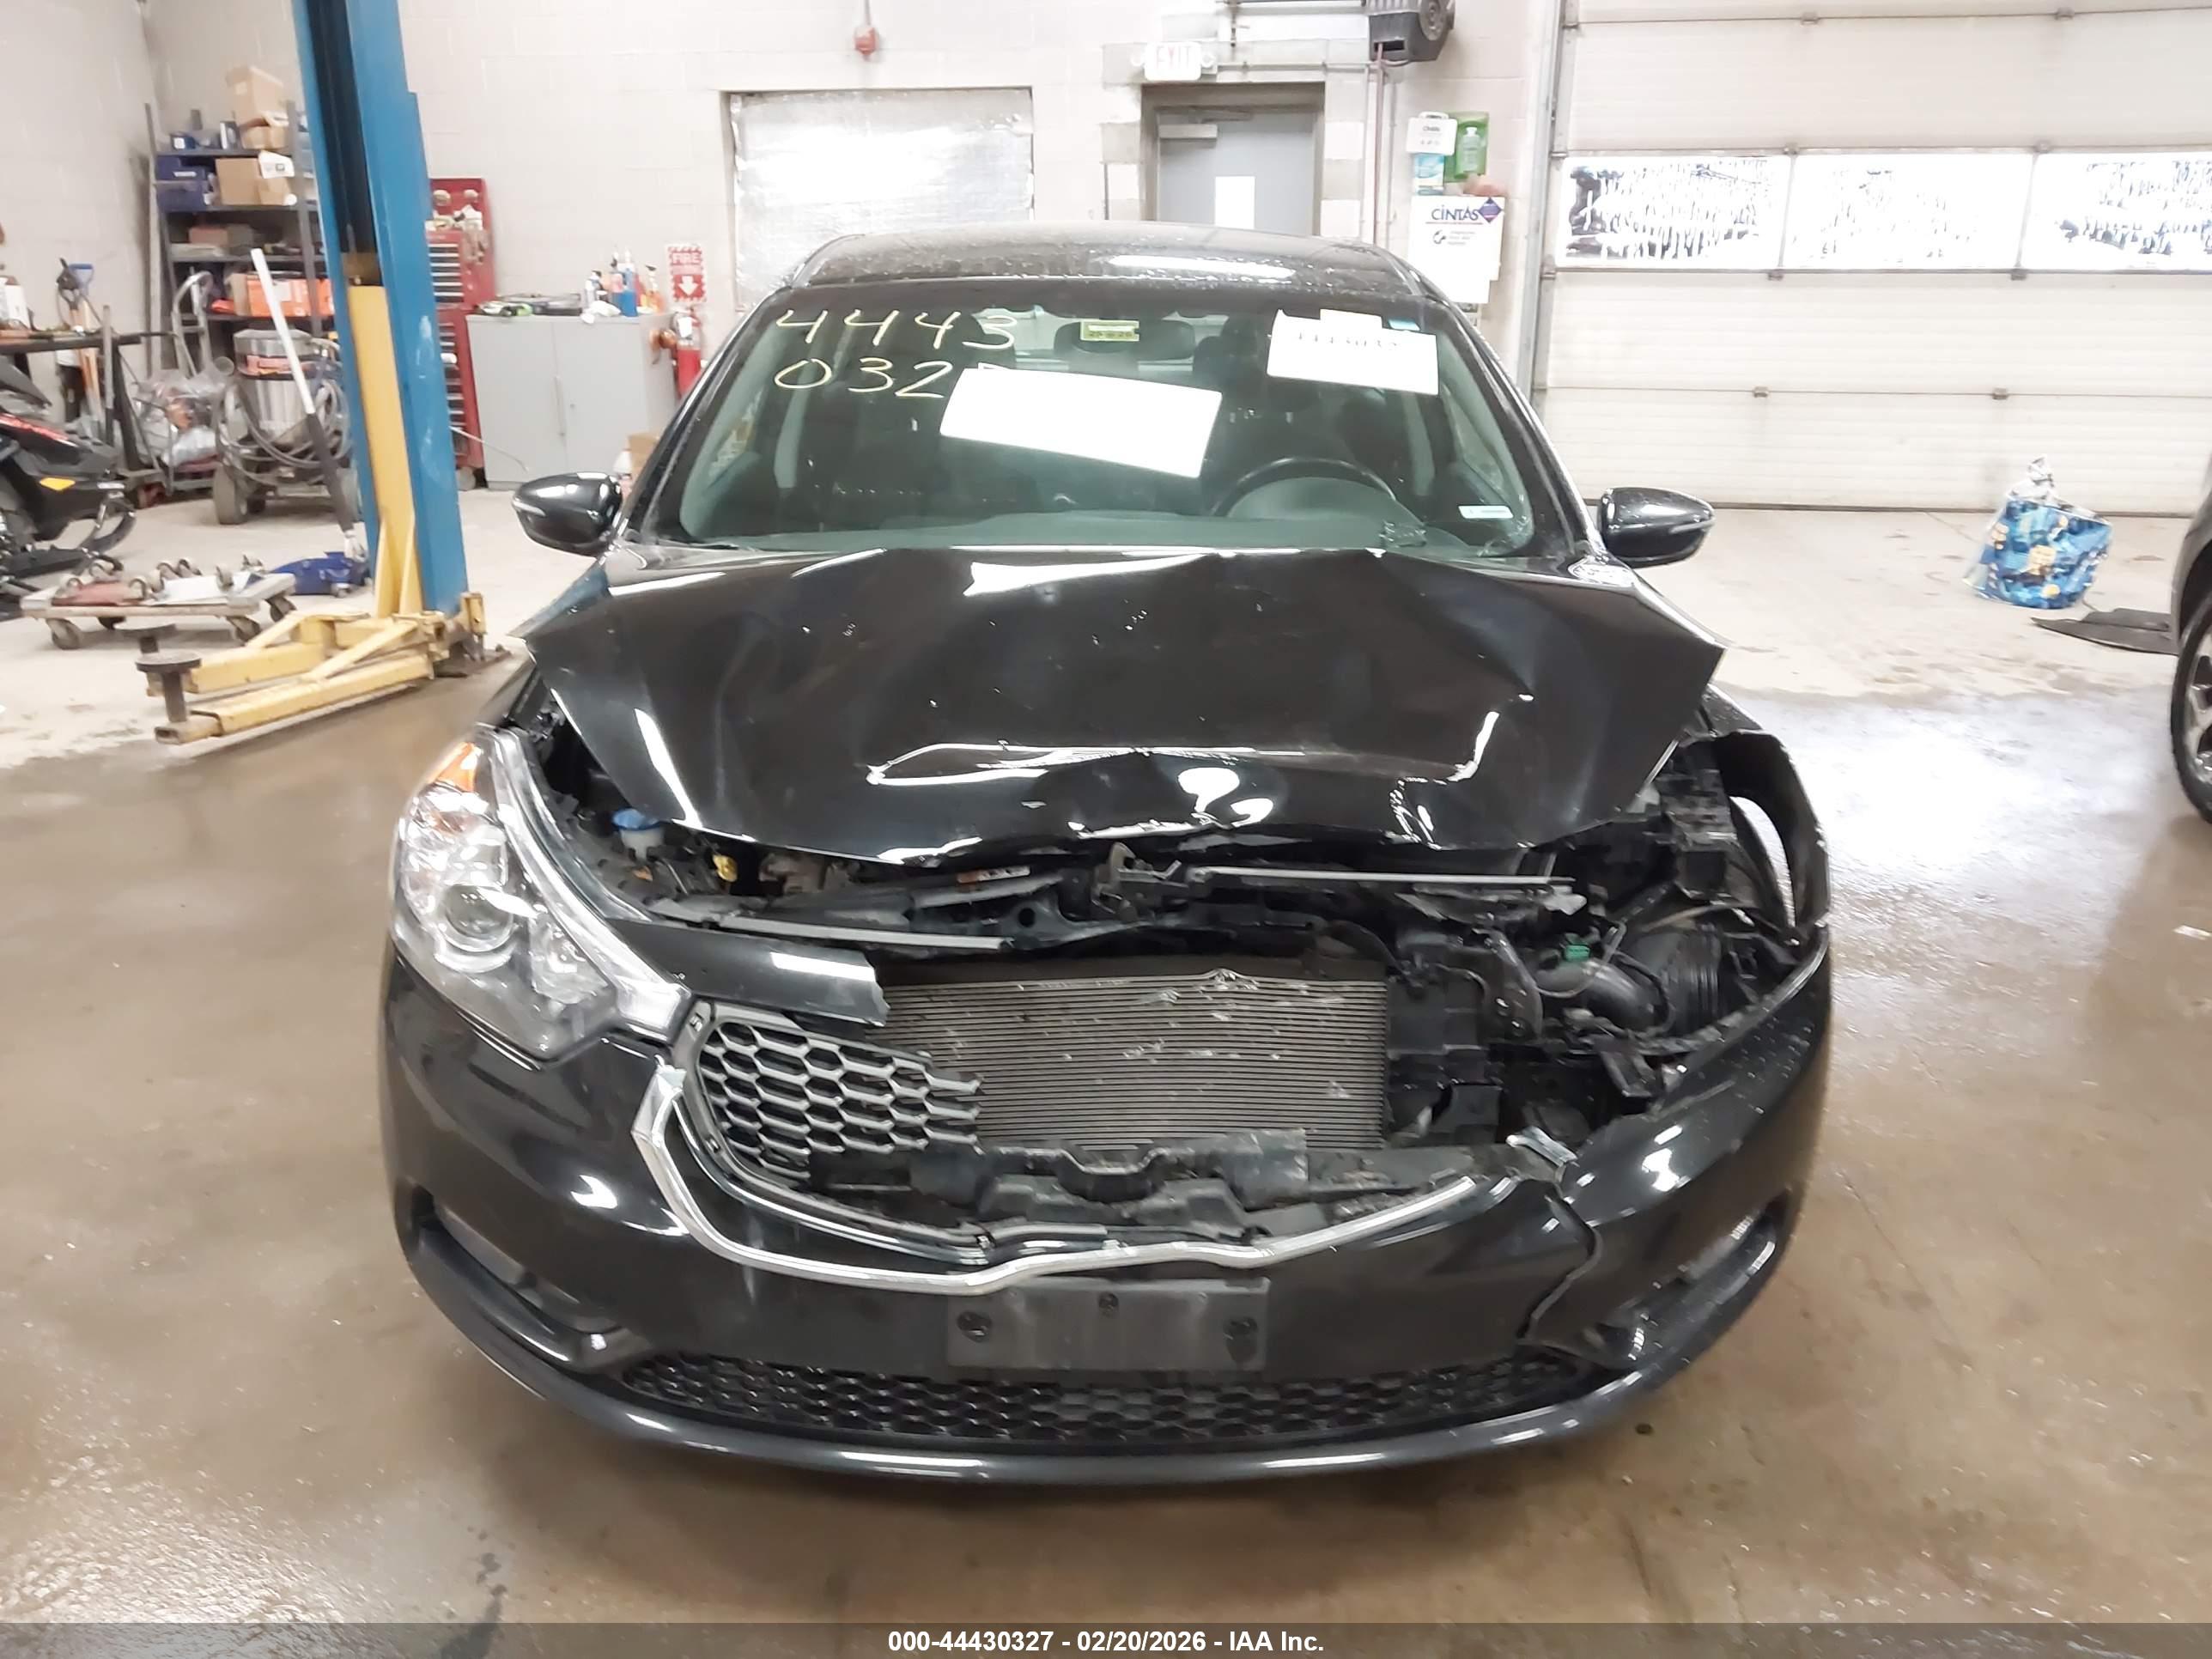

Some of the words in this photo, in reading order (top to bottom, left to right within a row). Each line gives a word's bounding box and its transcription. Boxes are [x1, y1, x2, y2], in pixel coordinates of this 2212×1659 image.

[672, 252, 702, 264] FIRE
[775, 309, 1018, 349] 4443
[775, 357, 1009, 398] 032
